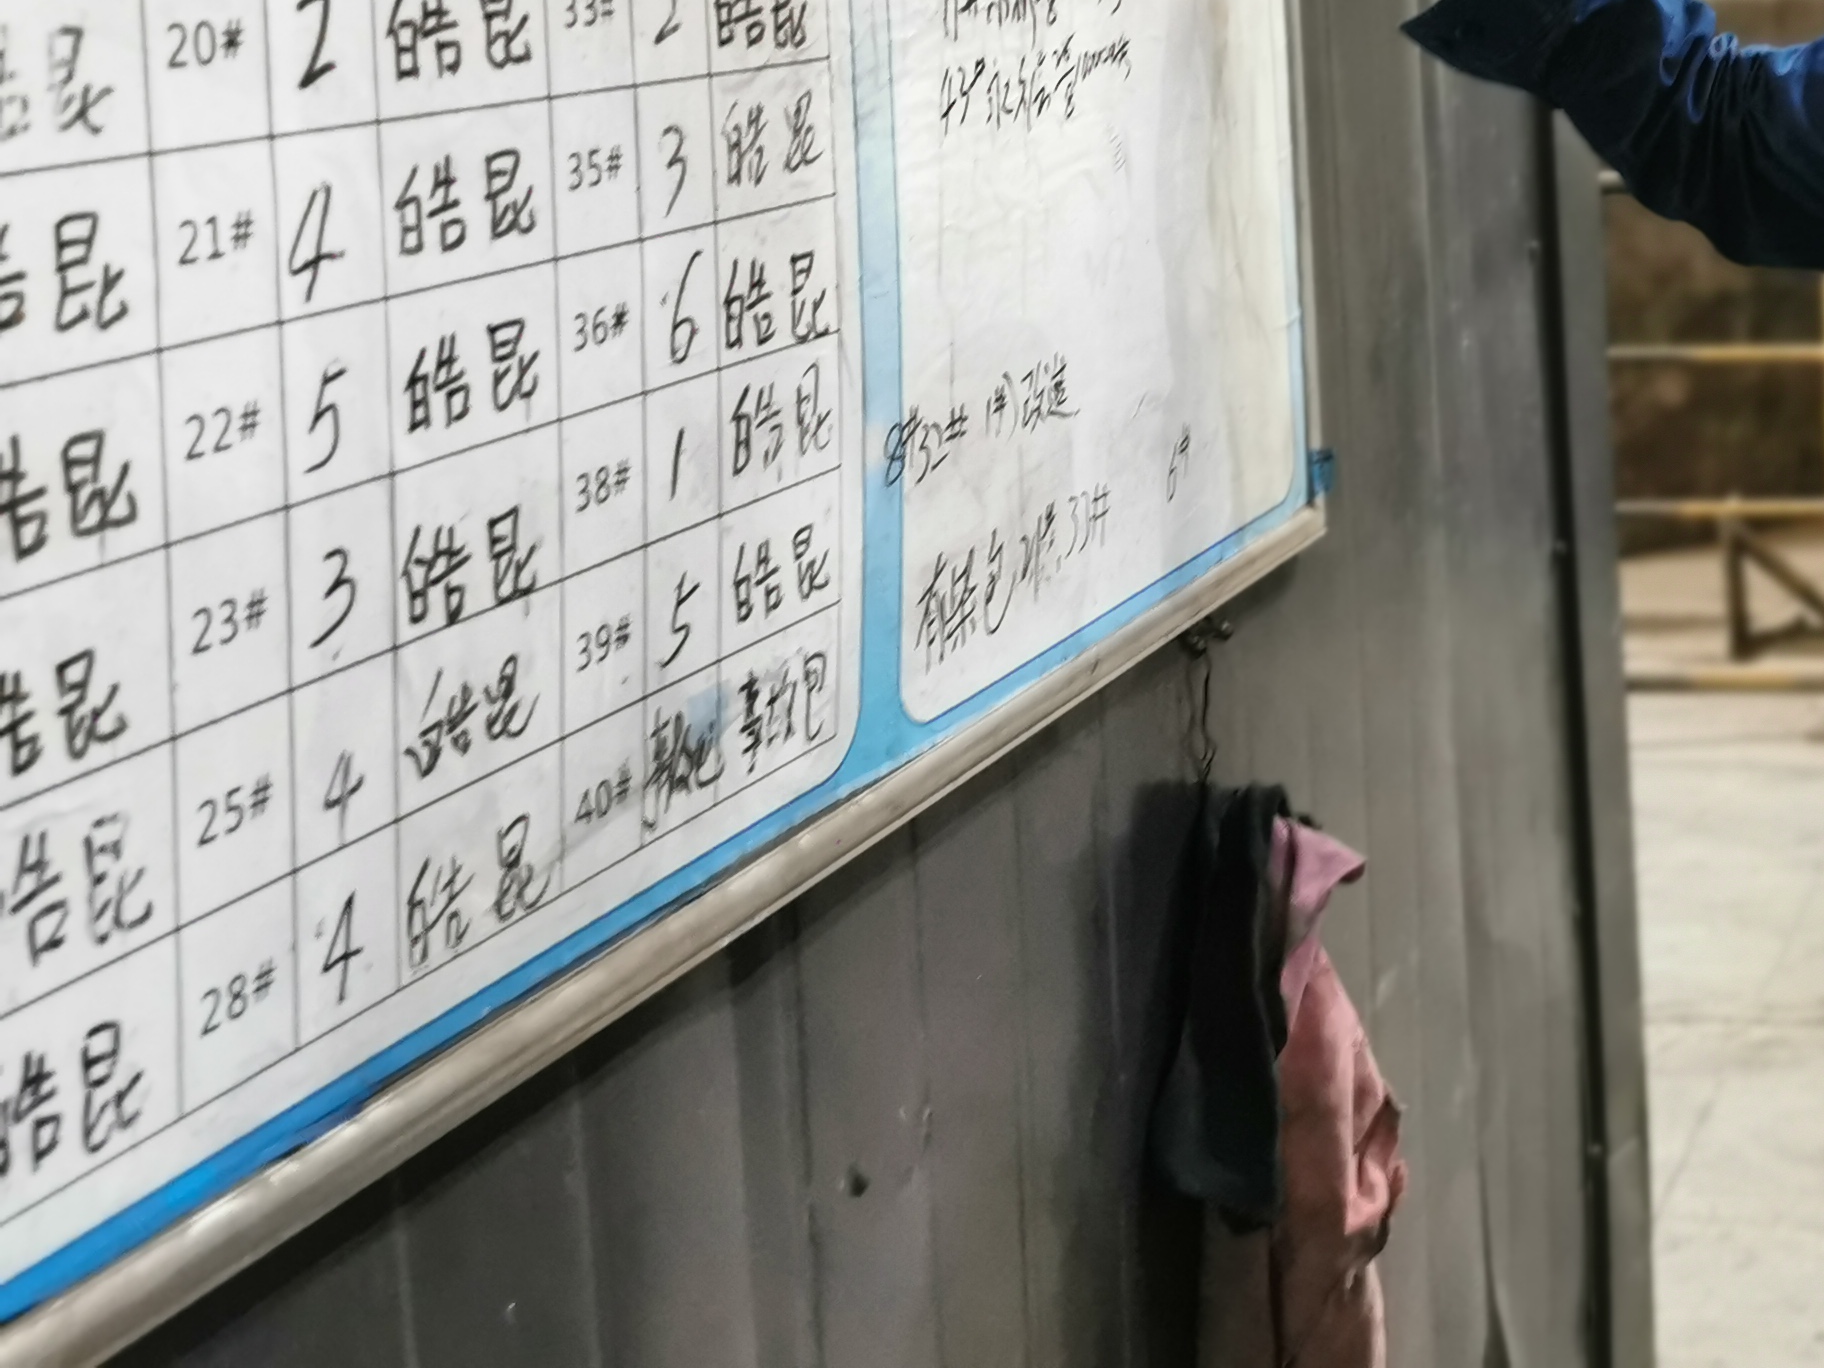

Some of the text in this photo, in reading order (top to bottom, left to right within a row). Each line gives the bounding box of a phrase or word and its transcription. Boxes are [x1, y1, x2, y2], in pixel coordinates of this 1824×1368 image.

[165, 18, 244, 70] 20#
[566, 145, 623, 192] 35#
[660, 123, 688, 218] 3
[177, 209, 254, 267] 21#
[289, 183, 346, 303] 4
[573, 301, 630, 354] 36#
[670, 250, 704, 365] 6
[184, 400, 261, 462] 22#
[304, 366, 348, 474] 5
[575, 459, 632, 515] 38#
[670, 426, 686, 501] 1
[190, 587, 268, 656] 23#
[310, 547, 358, 649] 3
[656, 571, 701, 669] 5
[575, 613, 632, 673] 39#
[195, 774, 275, 849] 25#
[322, 748, 365, 847] 4
[573, 759, 633, 826] 40#
[321, 889, 365, 1005] 4
[200, 957, 278, 1038] 28#
